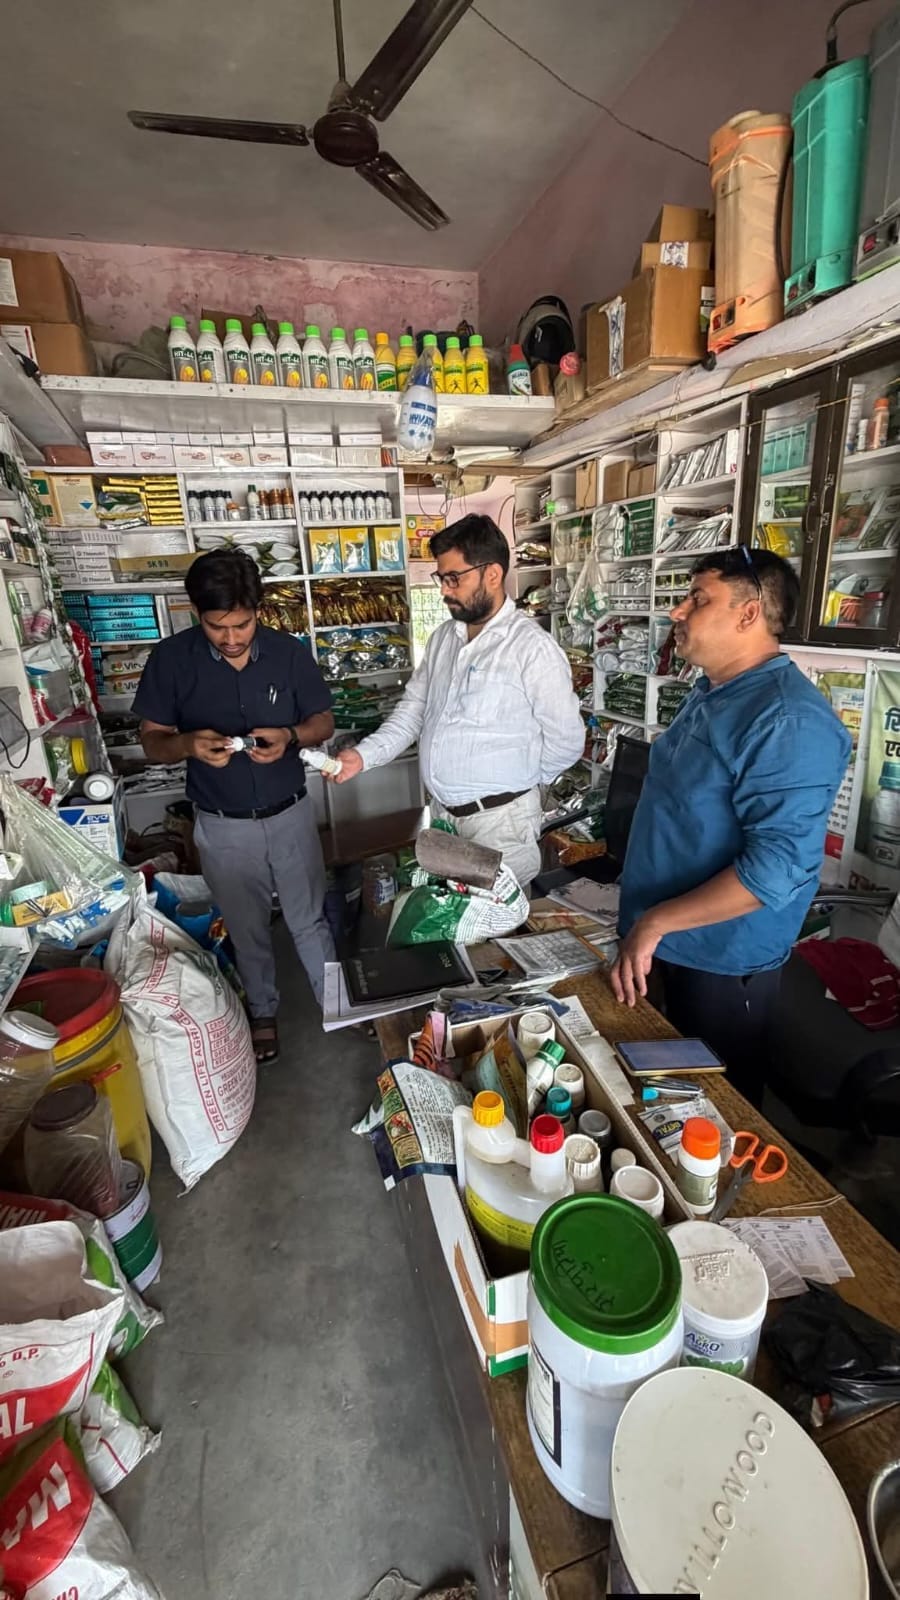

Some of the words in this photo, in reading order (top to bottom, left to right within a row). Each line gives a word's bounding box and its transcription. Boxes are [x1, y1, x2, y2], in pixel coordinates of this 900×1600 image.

[190, 1027, 203, 1057] AGRI
[197, 1061, 209, 1087] LIFE
[217, 1076, 238, 1097] GREEN
[203, 1090, 225, 1132] GREEN
[686, 1332, 720, 1352] AGRO
[672, 1411, 775, 1599] WILLOWOOD
